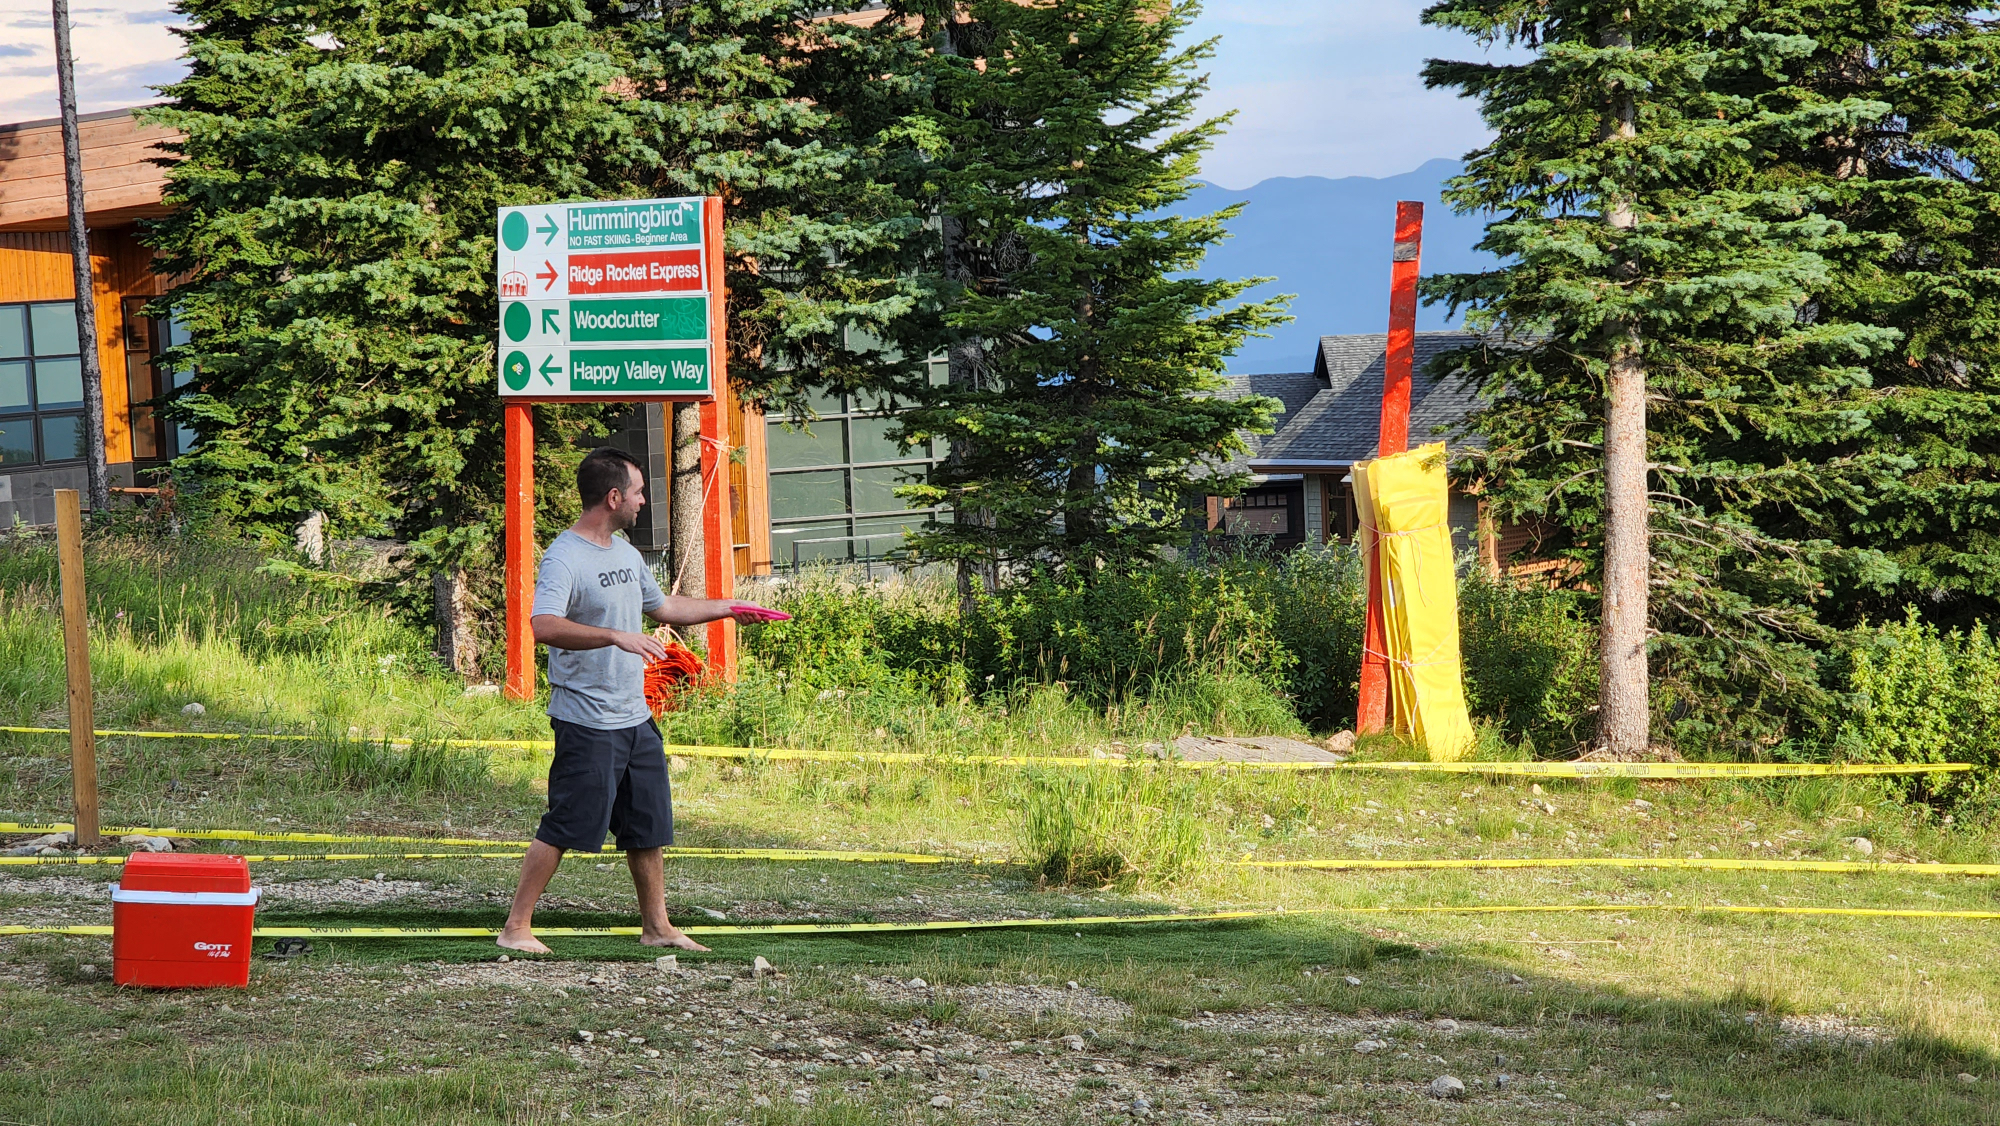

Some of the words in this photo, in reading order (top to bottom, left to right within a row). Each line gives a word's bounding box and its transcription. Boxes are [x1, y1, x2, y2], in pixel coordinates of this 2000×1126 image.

[569, 206, 683, 233] Hummingbird
[570, 236, 581, 246] NO
[584, 235, 602, 245] FAST
[604, 234, 630, 245] SKIING
[635, 234, 668, 245] Beginner
[670, 232, 687, 242] Area
[569, 266, 603, 285] Ridge
[606, 264, 647, 281] Rocket
[650, 262, 699, 283] Express
[574, 310, 659, 330] Woodcutter
[574, 361, 620, 384] Happy
[624, 360, 667, 384] Valley
[671, 360, 704, 384] Way
[1523, 765, 1548, 774] CAUTION
[1625, 765, 1650, 775] CAUTION
[1676, 765, 1701, 775] CAUTION
[1726, 765, 1750, 775] CAUTION
[1776, 765, 1800, 775] CAUTION
